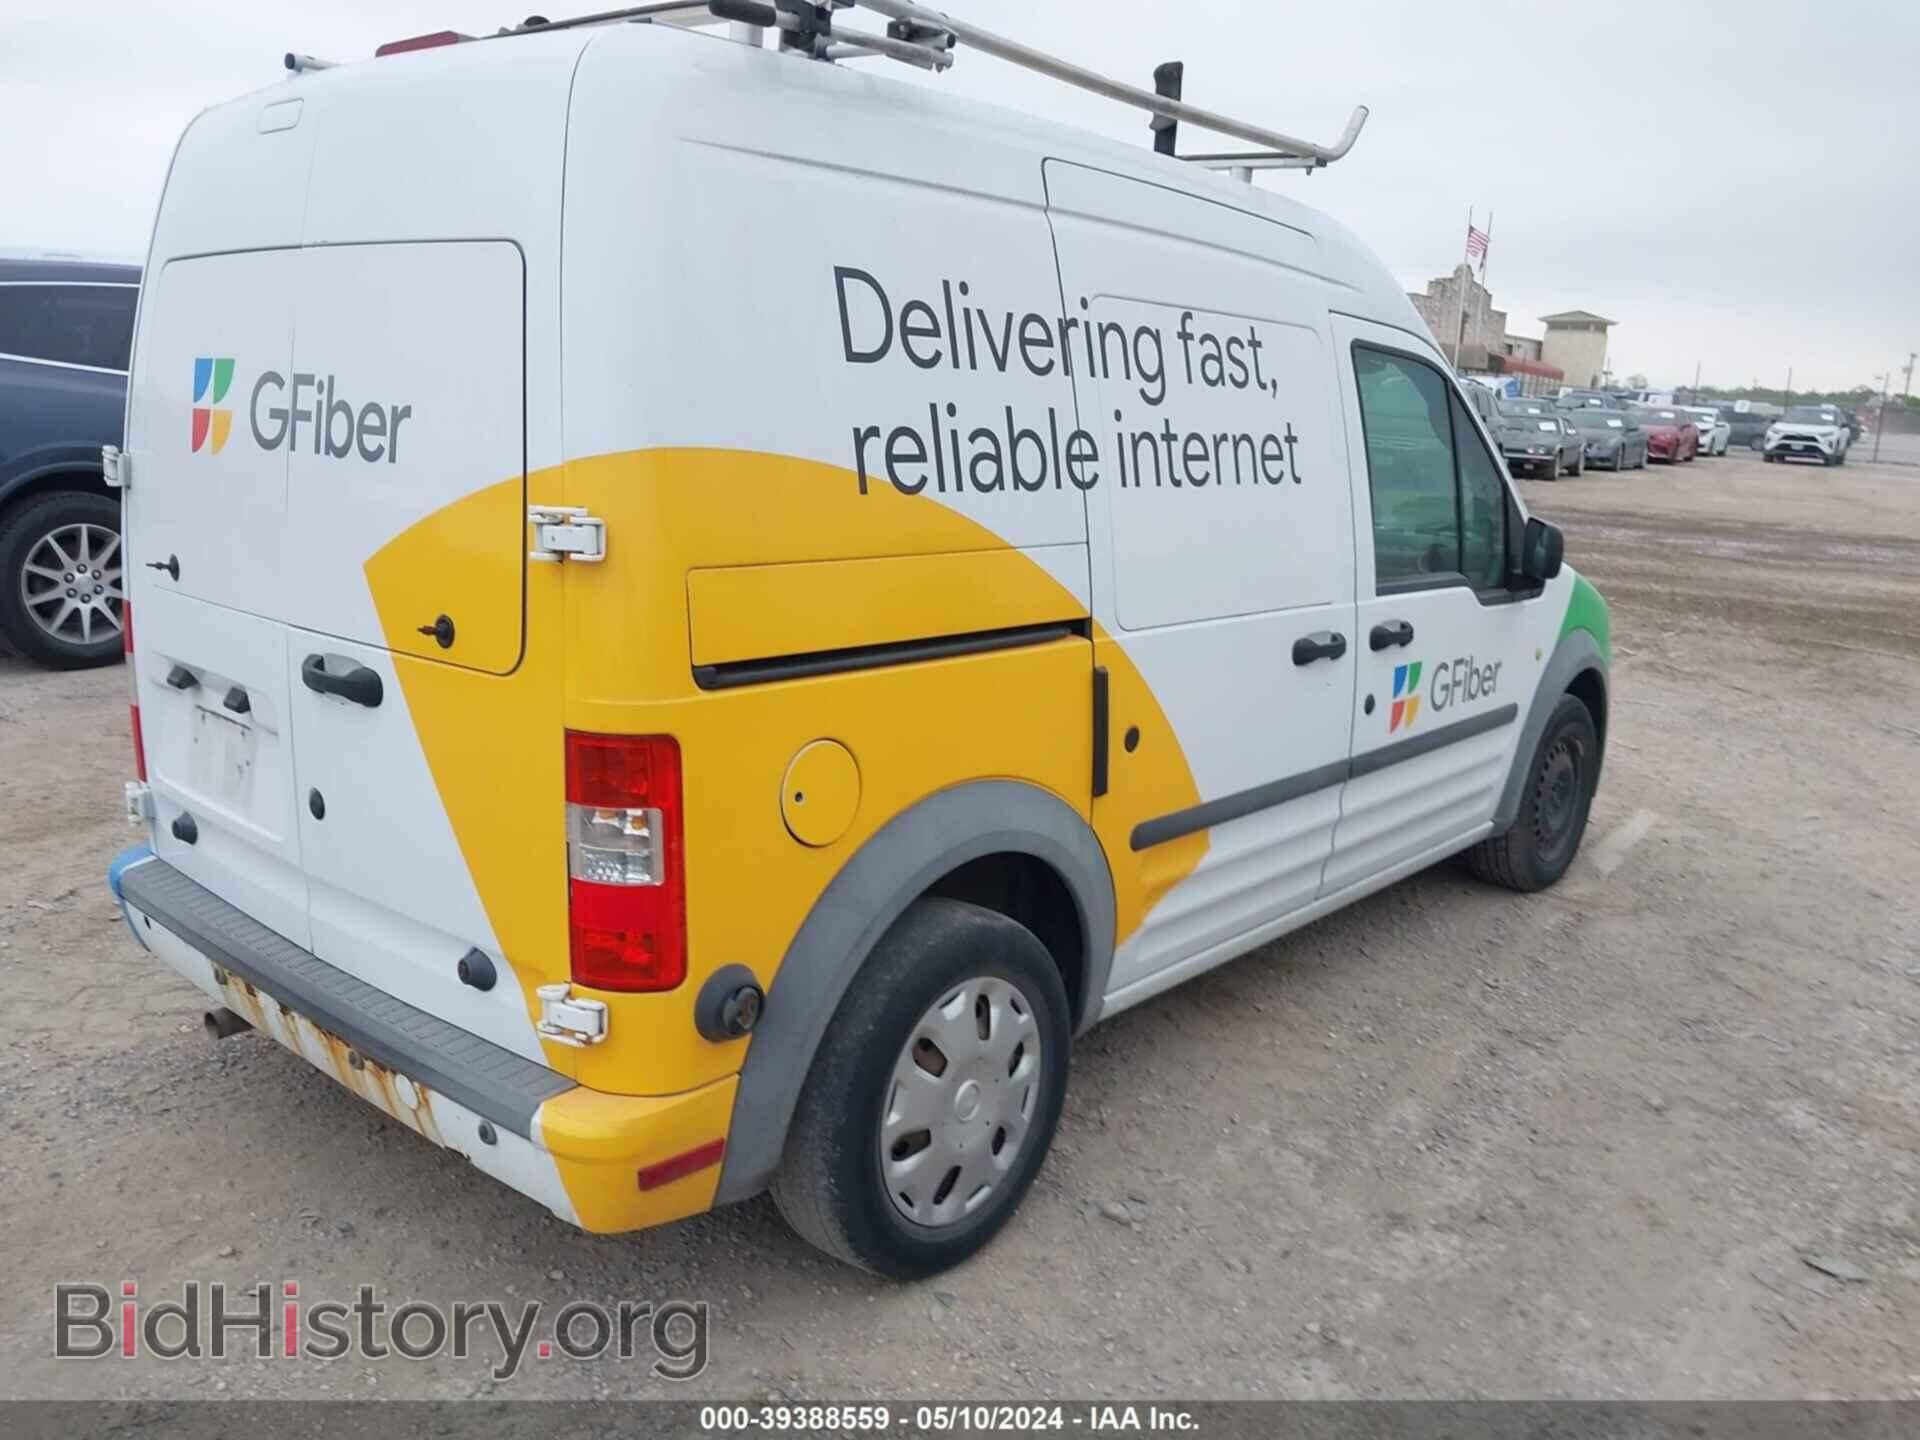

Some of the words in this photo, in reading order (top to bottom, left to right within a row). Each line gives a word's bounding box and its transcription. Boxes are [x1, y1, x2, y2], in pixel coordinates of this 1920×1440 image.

[833, 265, 1166, 406] Delivering
[1177, 312, 1279, 399] fast,
[249, 371, 412, 464] GFiber
[852, 402, 1099, 496] reliable
[1114, 409, 1302, 488] internet
[1431, 656, 1503, 712] GFiber
